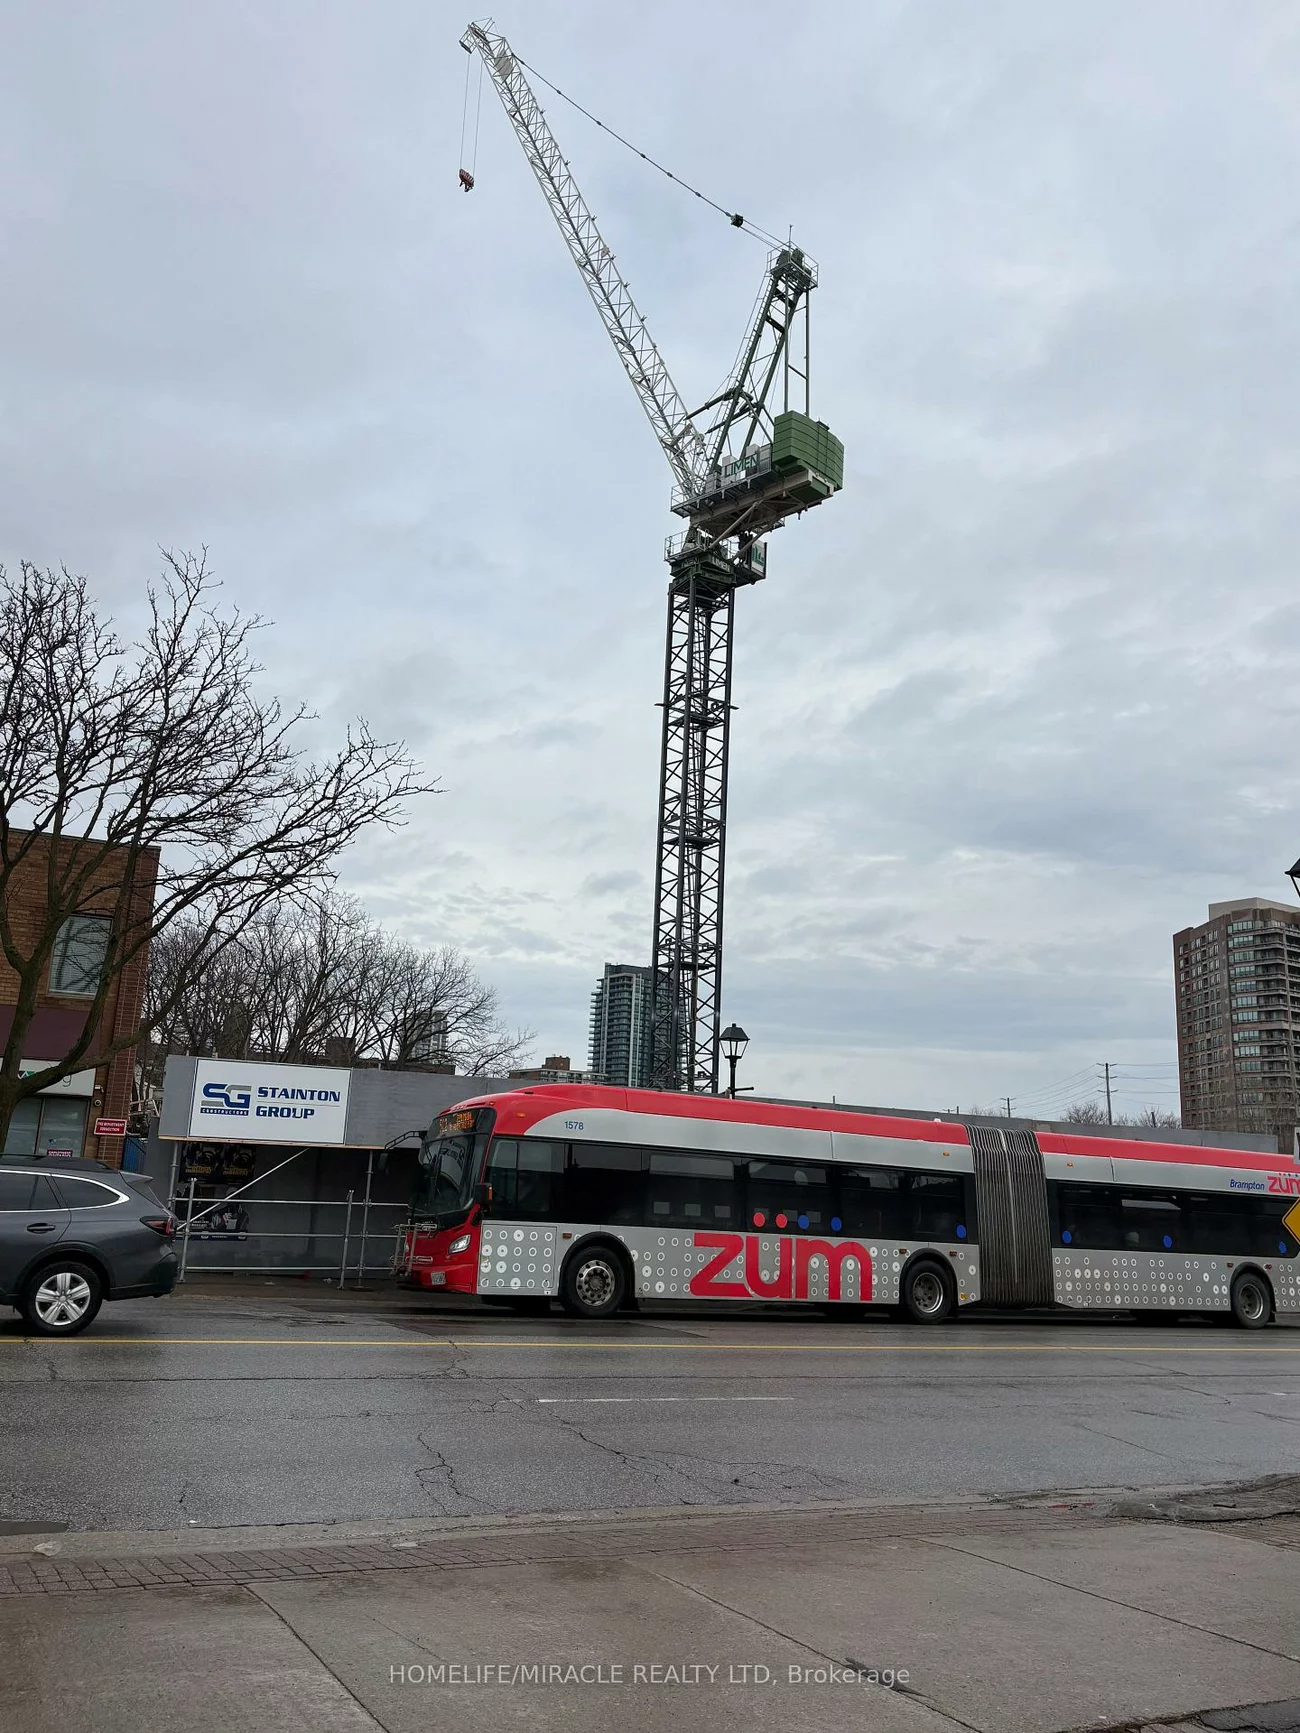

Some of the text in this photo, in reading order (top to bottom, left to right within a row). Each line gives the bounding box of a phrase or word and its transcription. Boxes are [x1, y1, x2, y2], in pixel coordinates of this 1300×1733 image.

[202, 1083, 252, 1108] SG
[257, 1086, 340, 1102] STAINTON
[255, 1105, 315, 1119] GROUP
[564, 1120, 584, 1130] 1578
[1229, 1179, 1265, 1191] Brampton
